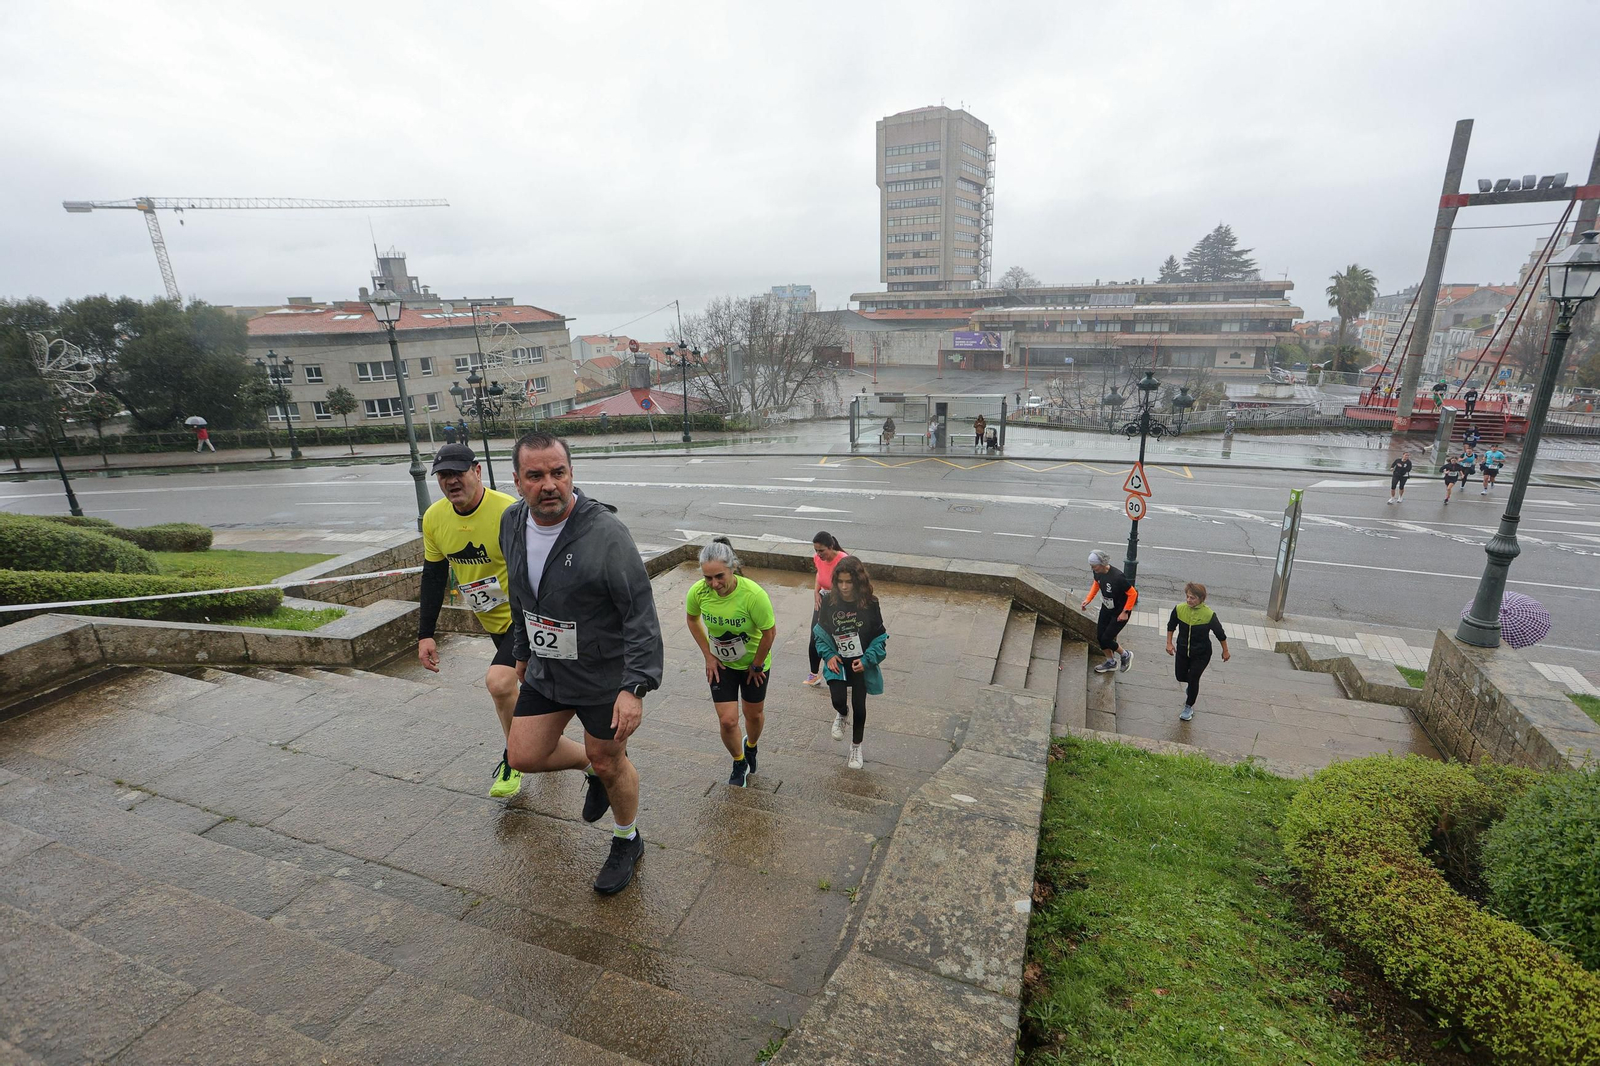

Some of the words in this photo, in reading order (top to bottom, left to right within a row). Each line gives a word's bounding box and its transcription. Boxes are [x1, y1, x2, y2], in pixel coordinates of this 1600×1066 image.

[1128, 501, 1141, 513] 30
[470, 590, 490, 608] 23
[724, 617, 746, 628] auga
[533, 630, 558, 649] 62
[714, 646, 737, 657] 101
